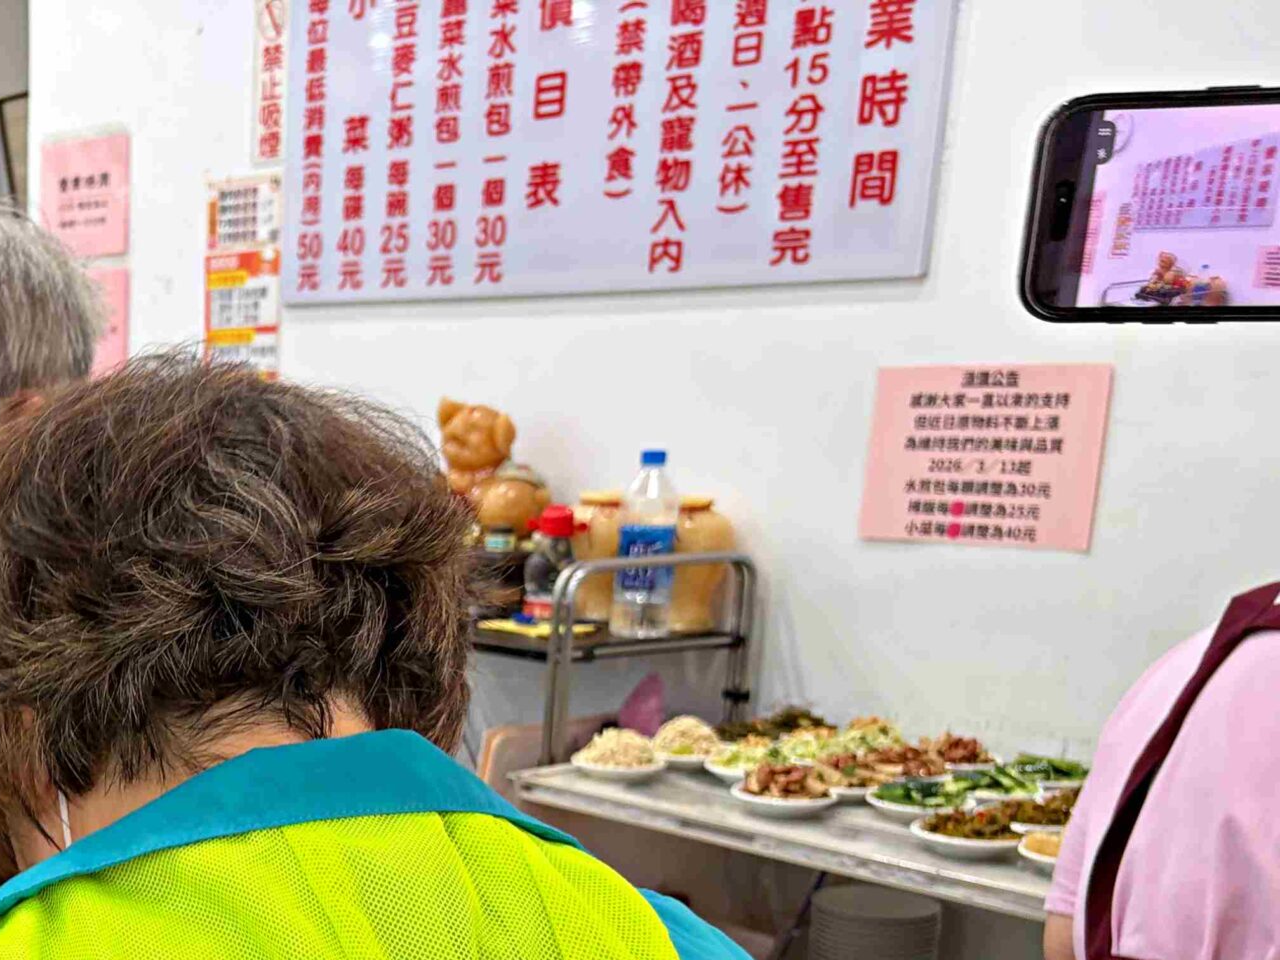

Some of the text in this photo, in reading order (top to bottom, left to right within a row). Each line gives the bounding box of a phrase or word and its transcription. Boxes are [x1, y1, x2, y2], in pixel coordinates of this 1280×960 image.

[649, 0, 706, 273] 喝酒及寵物入內
[769, 5, 834, 266] 點15分至售完
[849, 0, 915, 209] 業時間
[904, 521, 1037, 542] 小菜每調整為40元
